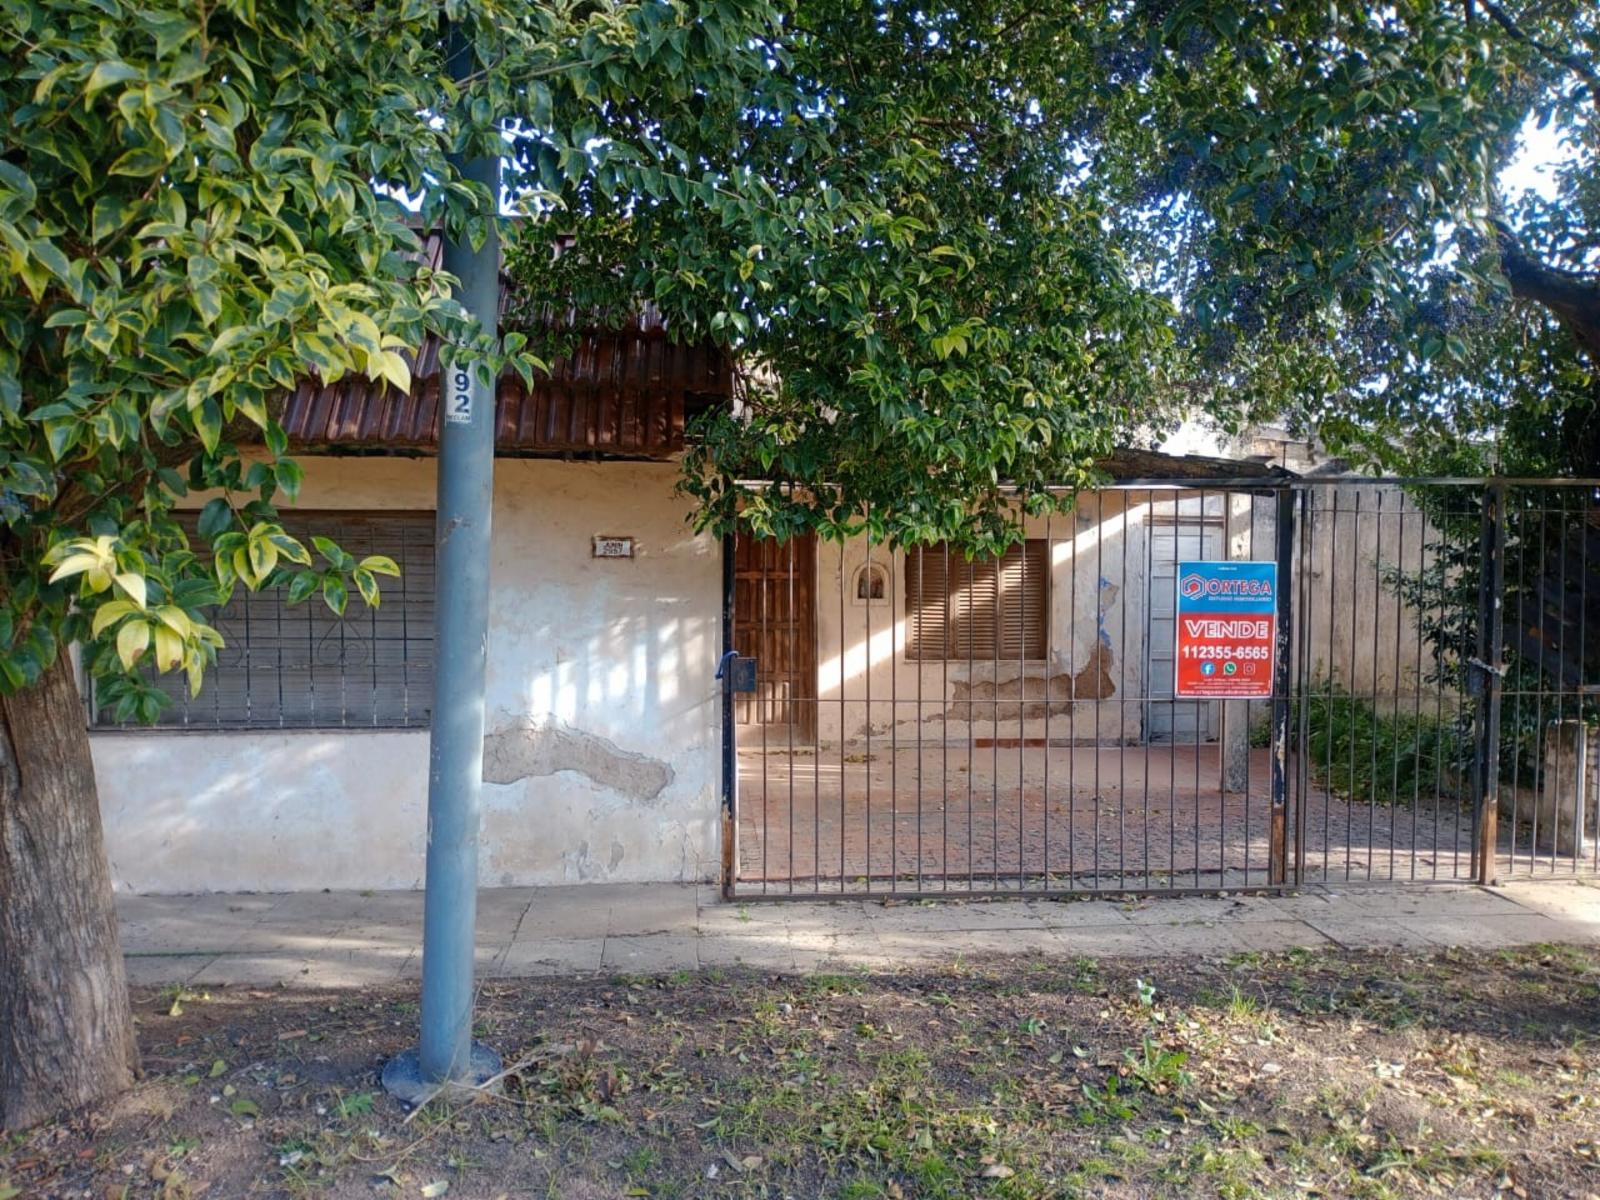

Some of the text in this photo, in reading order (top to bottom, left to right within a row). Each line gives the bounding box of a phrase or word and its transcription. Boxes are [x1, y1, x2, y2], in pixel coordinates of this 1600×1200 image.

[1207, 578, 1272, 596] ORTEGA
[1184, 619, 1269, 639] VENDE
[1182, 645, 1269, 660] 112355-6565
